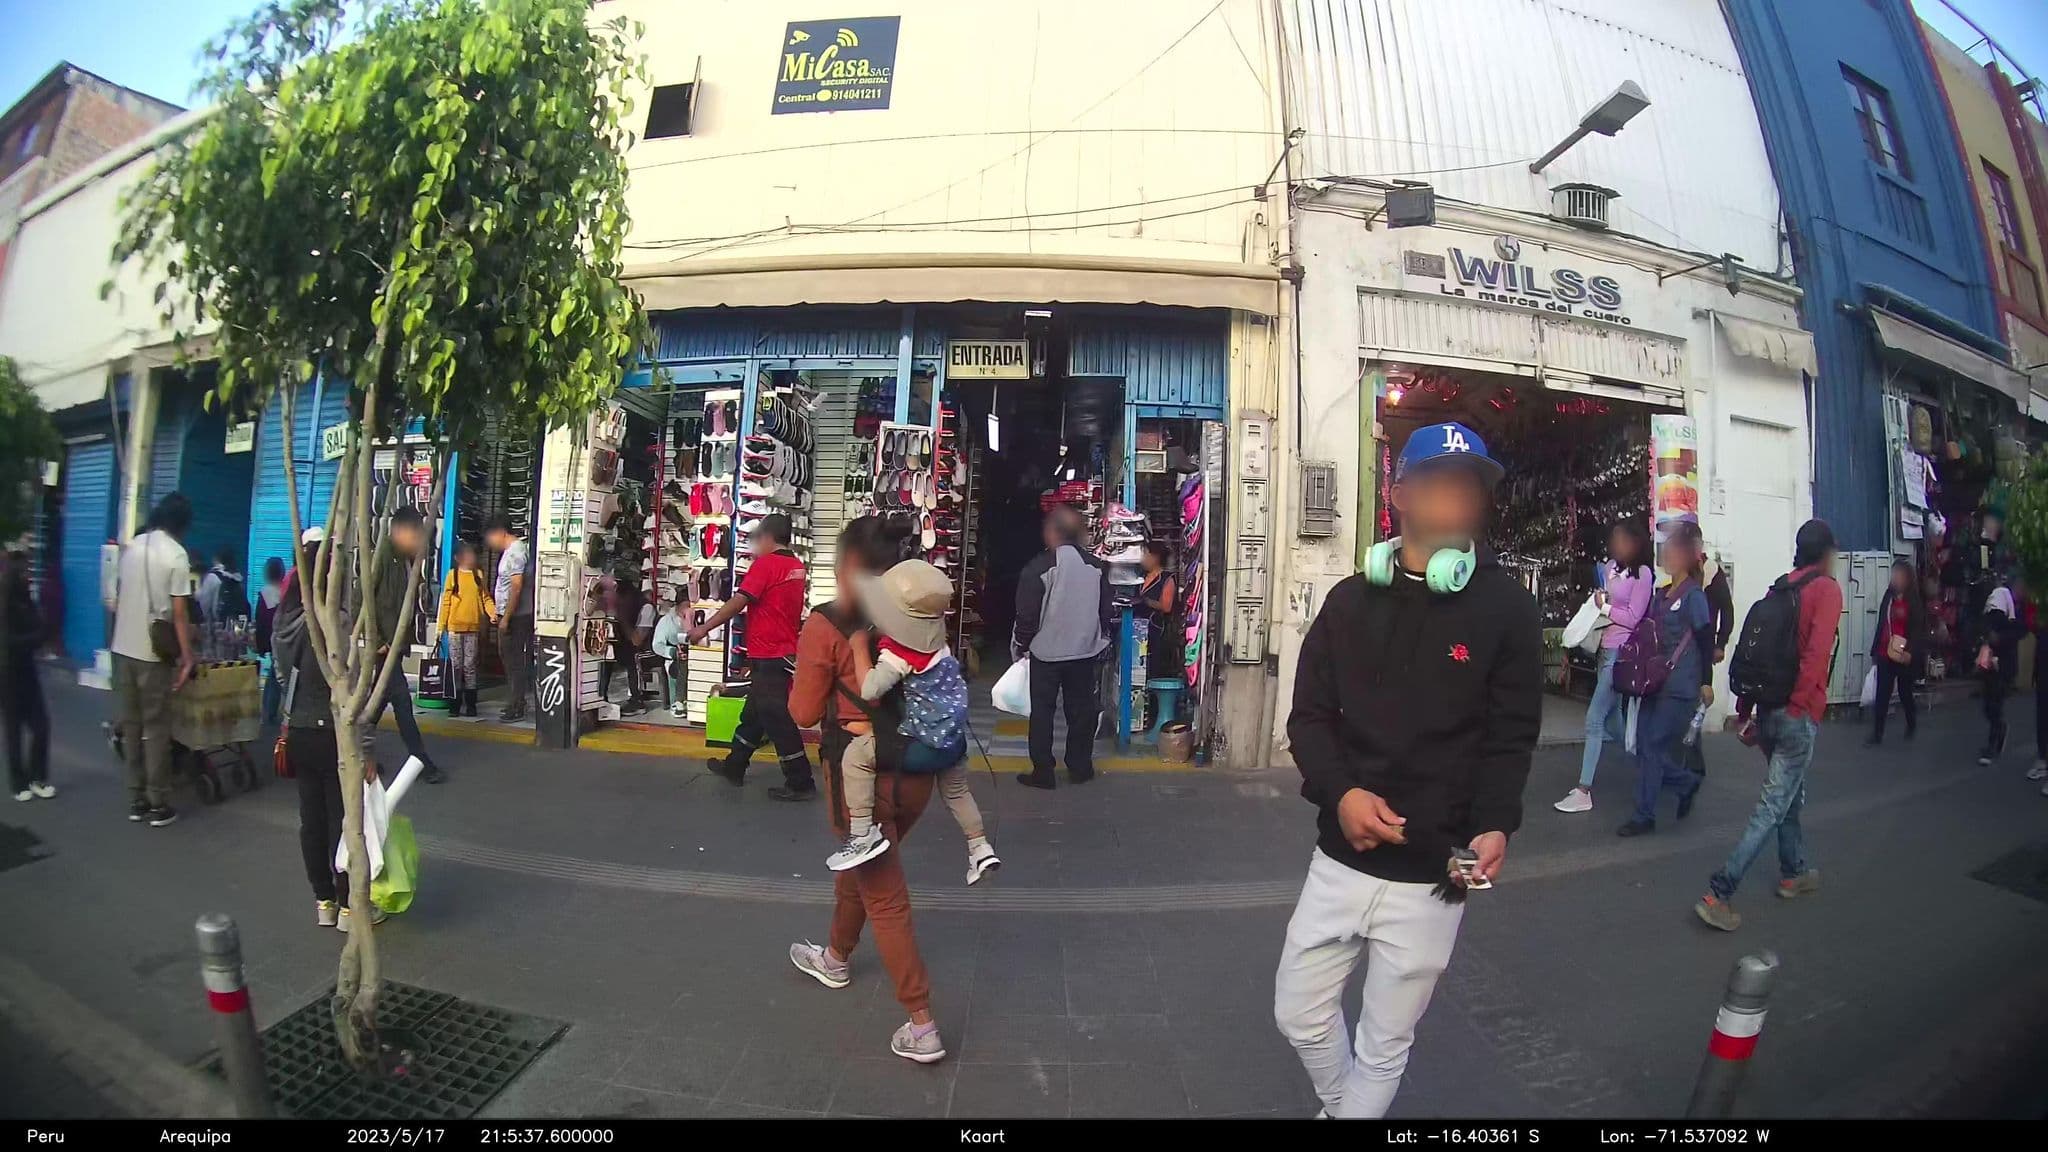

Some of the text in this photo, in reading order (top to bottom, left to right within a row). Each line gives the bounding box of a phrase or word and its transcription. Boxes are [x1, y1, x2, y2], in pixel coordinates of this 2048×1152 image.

[778, 88, 882, 103] Central 914041211
[1440, 284, 1631, 326] La marca del cuero
[951, 345, 1024, 366] ENTRADA
[1442, 425, 1470, 452] LA
